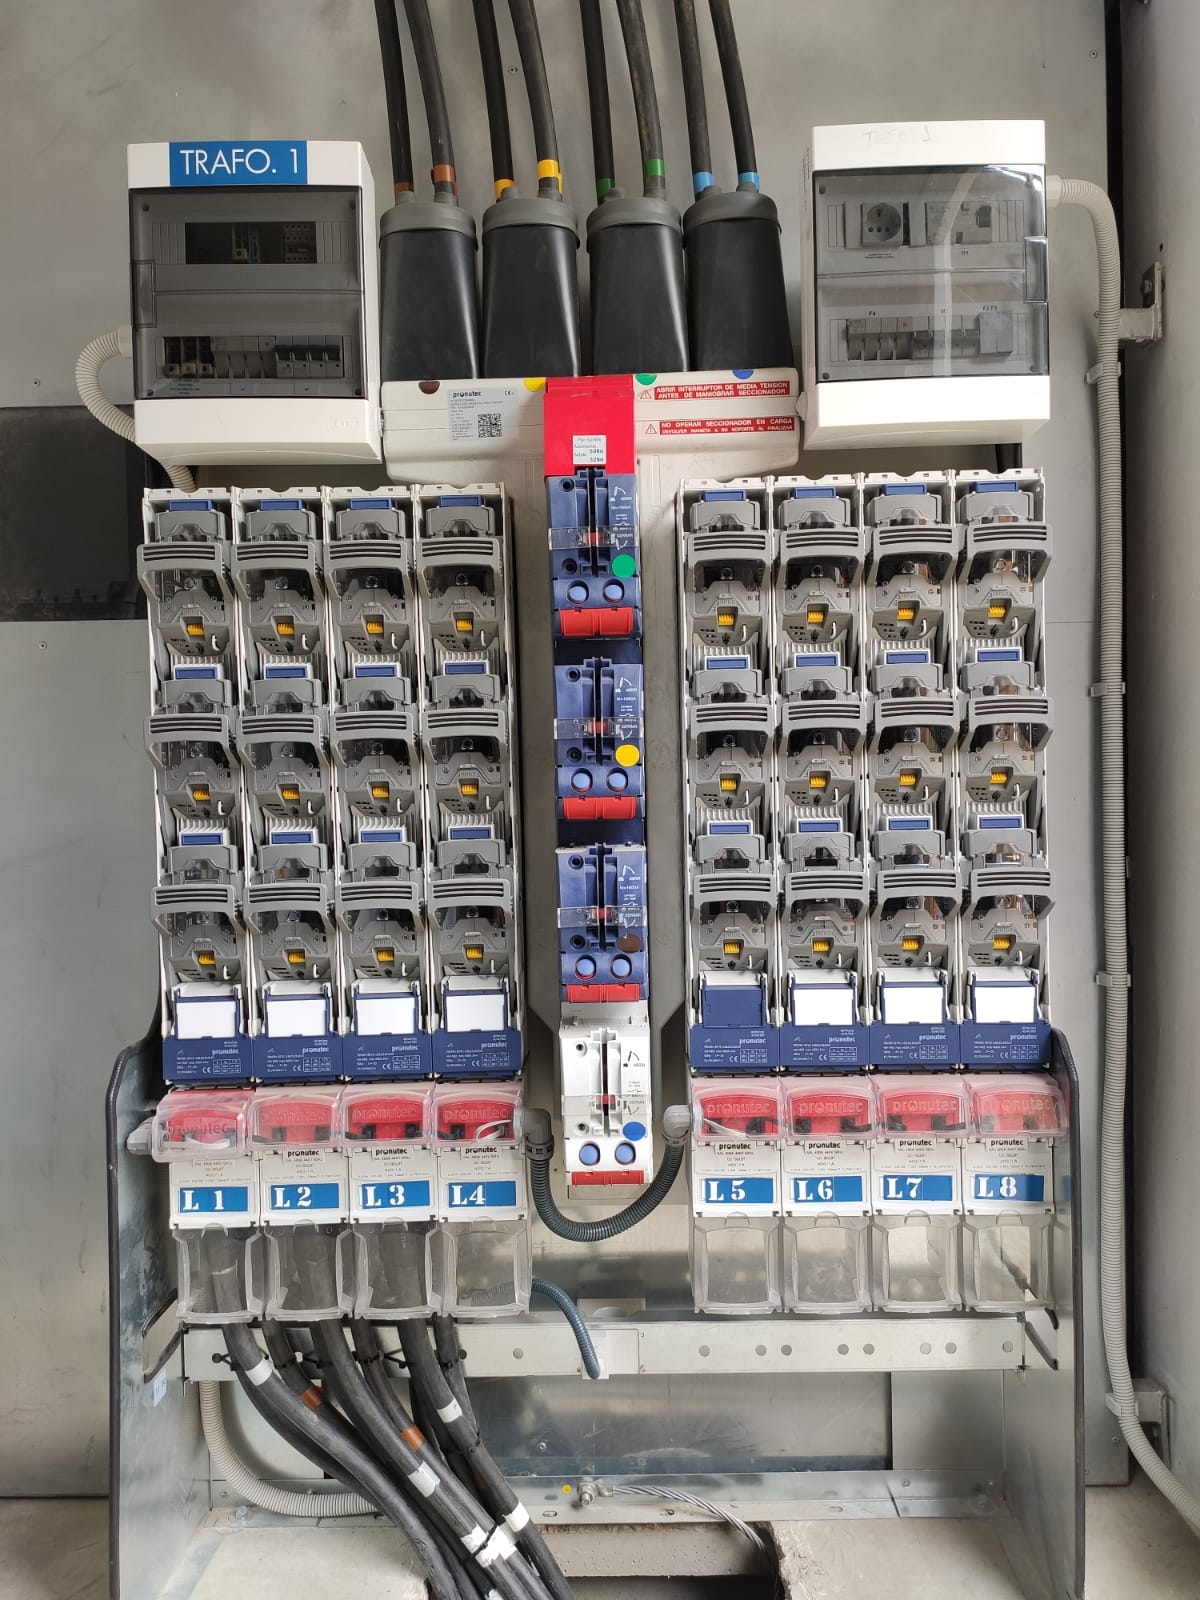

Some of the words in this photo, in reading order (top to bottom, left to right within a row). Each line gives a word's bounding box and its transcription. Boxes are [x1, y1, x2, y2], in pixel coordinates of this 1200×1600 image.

[179, 148, 277, 176] TRAFO.
[290, 148, 299, 174] 1
[707, 1101, 770, 1116] pronutec
[799, 1100, 863, 1116] pronutec
[892, 1098, 957, 1114] pronutec
[443, 1106, 509, 1123] pronutec
[718, 1142, 751, 1151] pronutec
[808, 1142, 840, 1150] pronutec
[899, 1139, 932, 1147] pronutec
[991, 1138, 1024, 1147] pronutec
[287, 1149, 320, 1158] pronutec
[375, 1148, 408, 1156] pronutec
[465, 1146, 497, 1155] pronutec
[451, 1184, 486, 1205] L4
